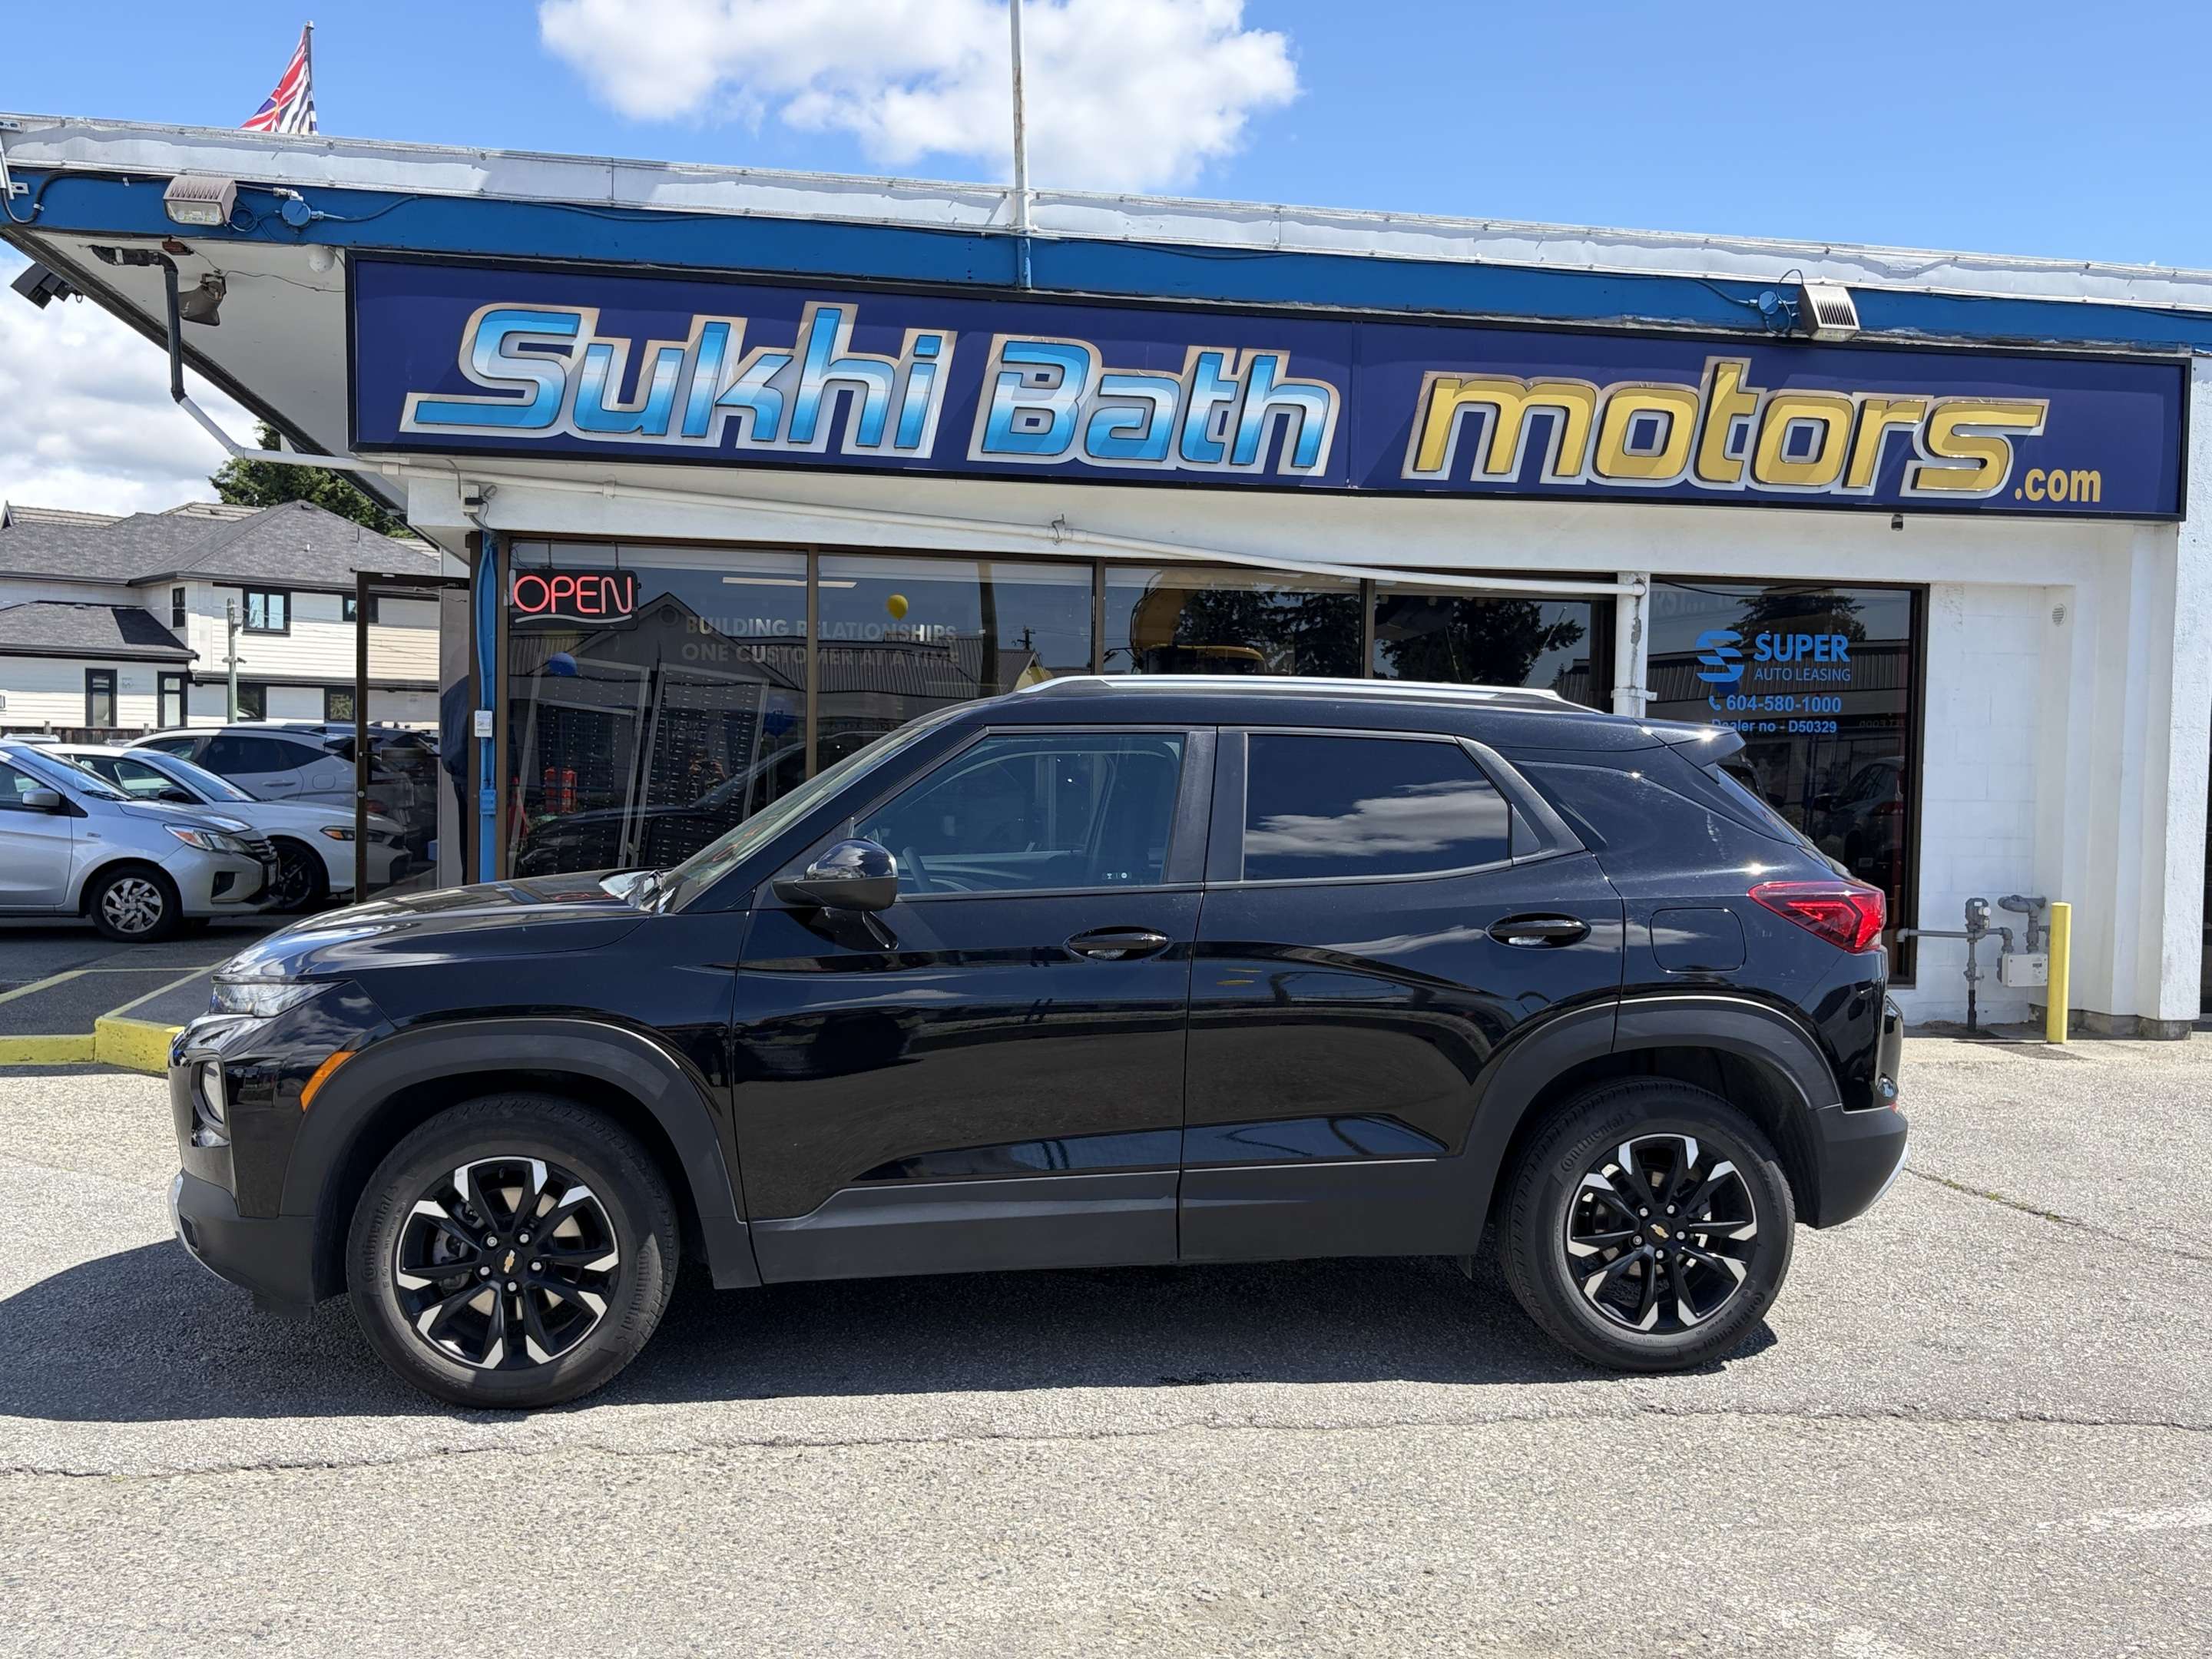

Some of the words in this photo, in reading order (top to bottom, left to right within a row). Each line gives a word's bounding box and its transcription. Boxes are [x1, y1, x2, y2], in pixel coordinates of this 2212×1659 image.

[399, 301, 958, 459] Sukhi
[967, 334, 1340, 476] Bath
[1400, 356, 2049, 498] motors
[2015, 466, 2101, 504] .com
[514, 575, 633, 614] OPEN
[686, 616, 789, 636] BUILDING
[681, 644, 729, 661] ONE
[1753, 633, 1851, 663] SUPER
[1754, 667, 1793, 680] AUTO
[1796, 668, 1851, 681] LEASING
[1726, 694, 1842, 713] 604-580-1000
[1759, 722, 1777, 732] no
[1788, 720, 1837, 733] D50329
